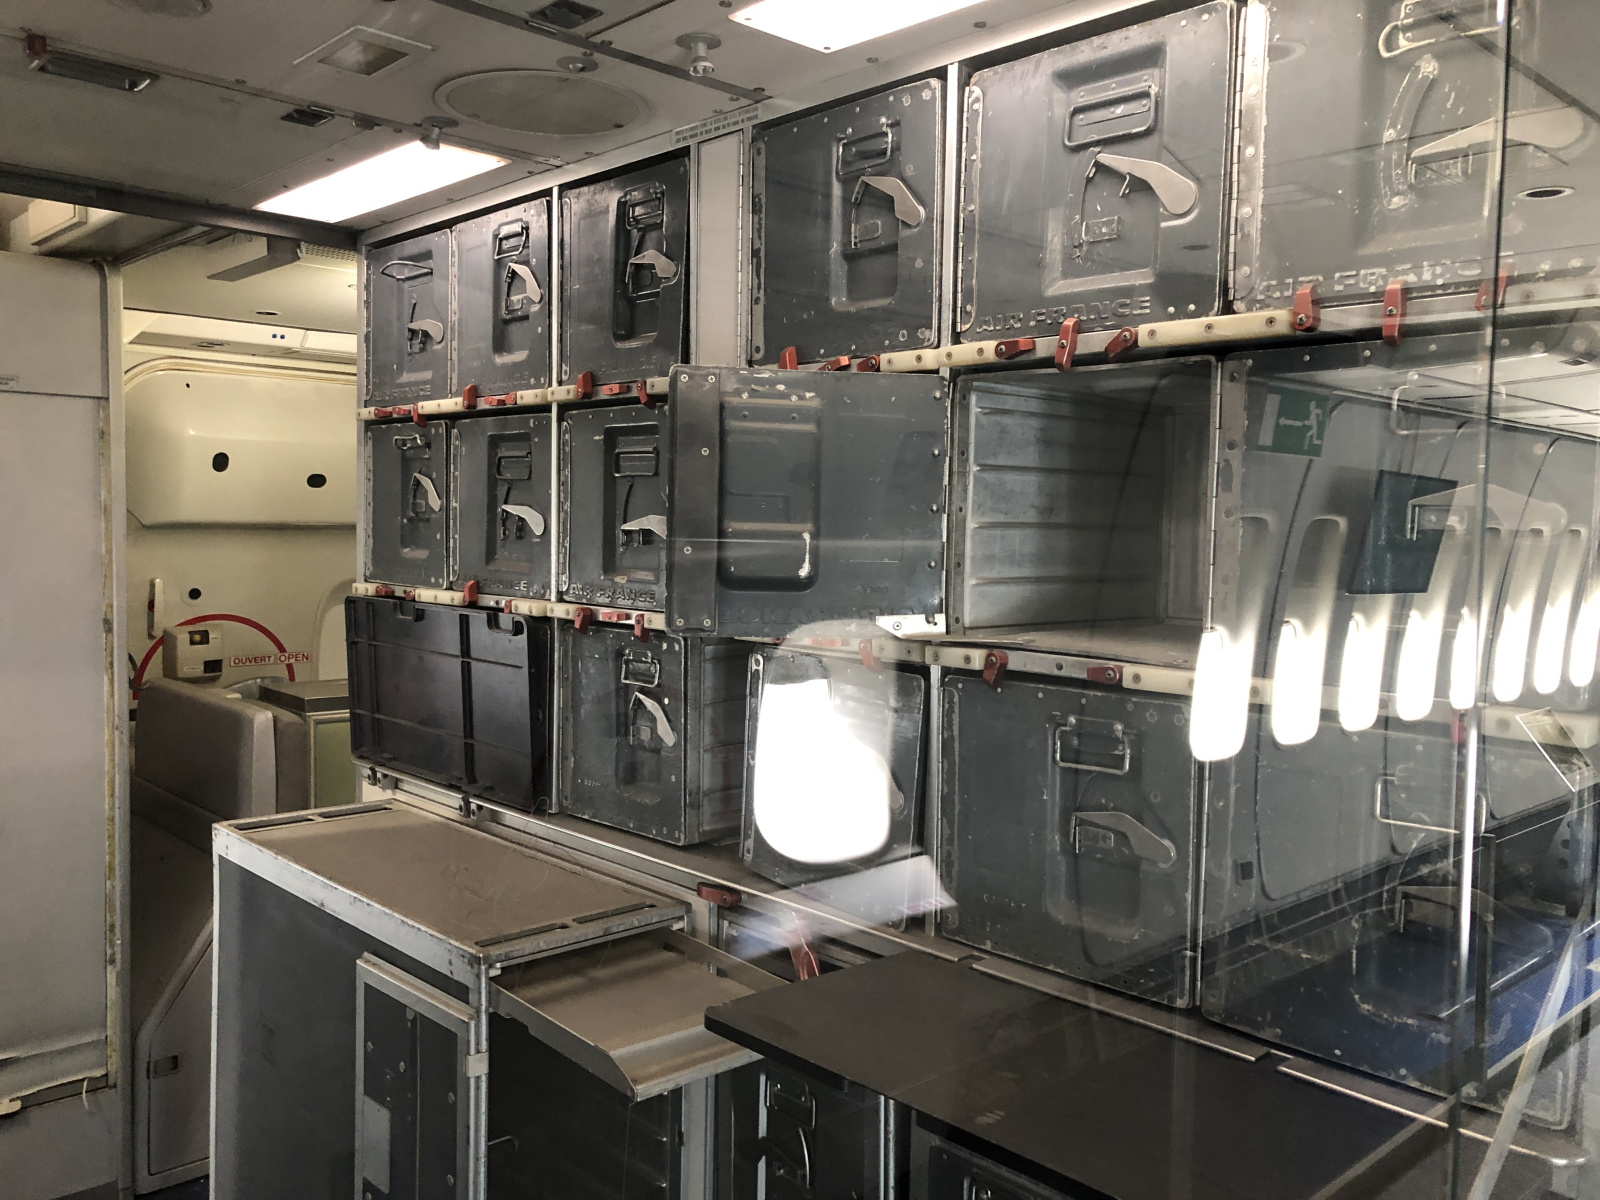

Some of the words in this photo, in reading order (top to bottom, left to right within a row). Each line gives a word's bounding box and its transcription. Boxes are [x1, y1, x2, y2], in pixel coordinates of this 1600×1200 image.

[976, 312, 1024, 333] AIR
[1029, 296, 1150, 326] FRANCE
[569, 583, 593, 599] AIR
[596, 585, 656, 603] FRANCE
[233, 655, 272, 665] OUVERT
[278, 653, 309, 663] OPEN
